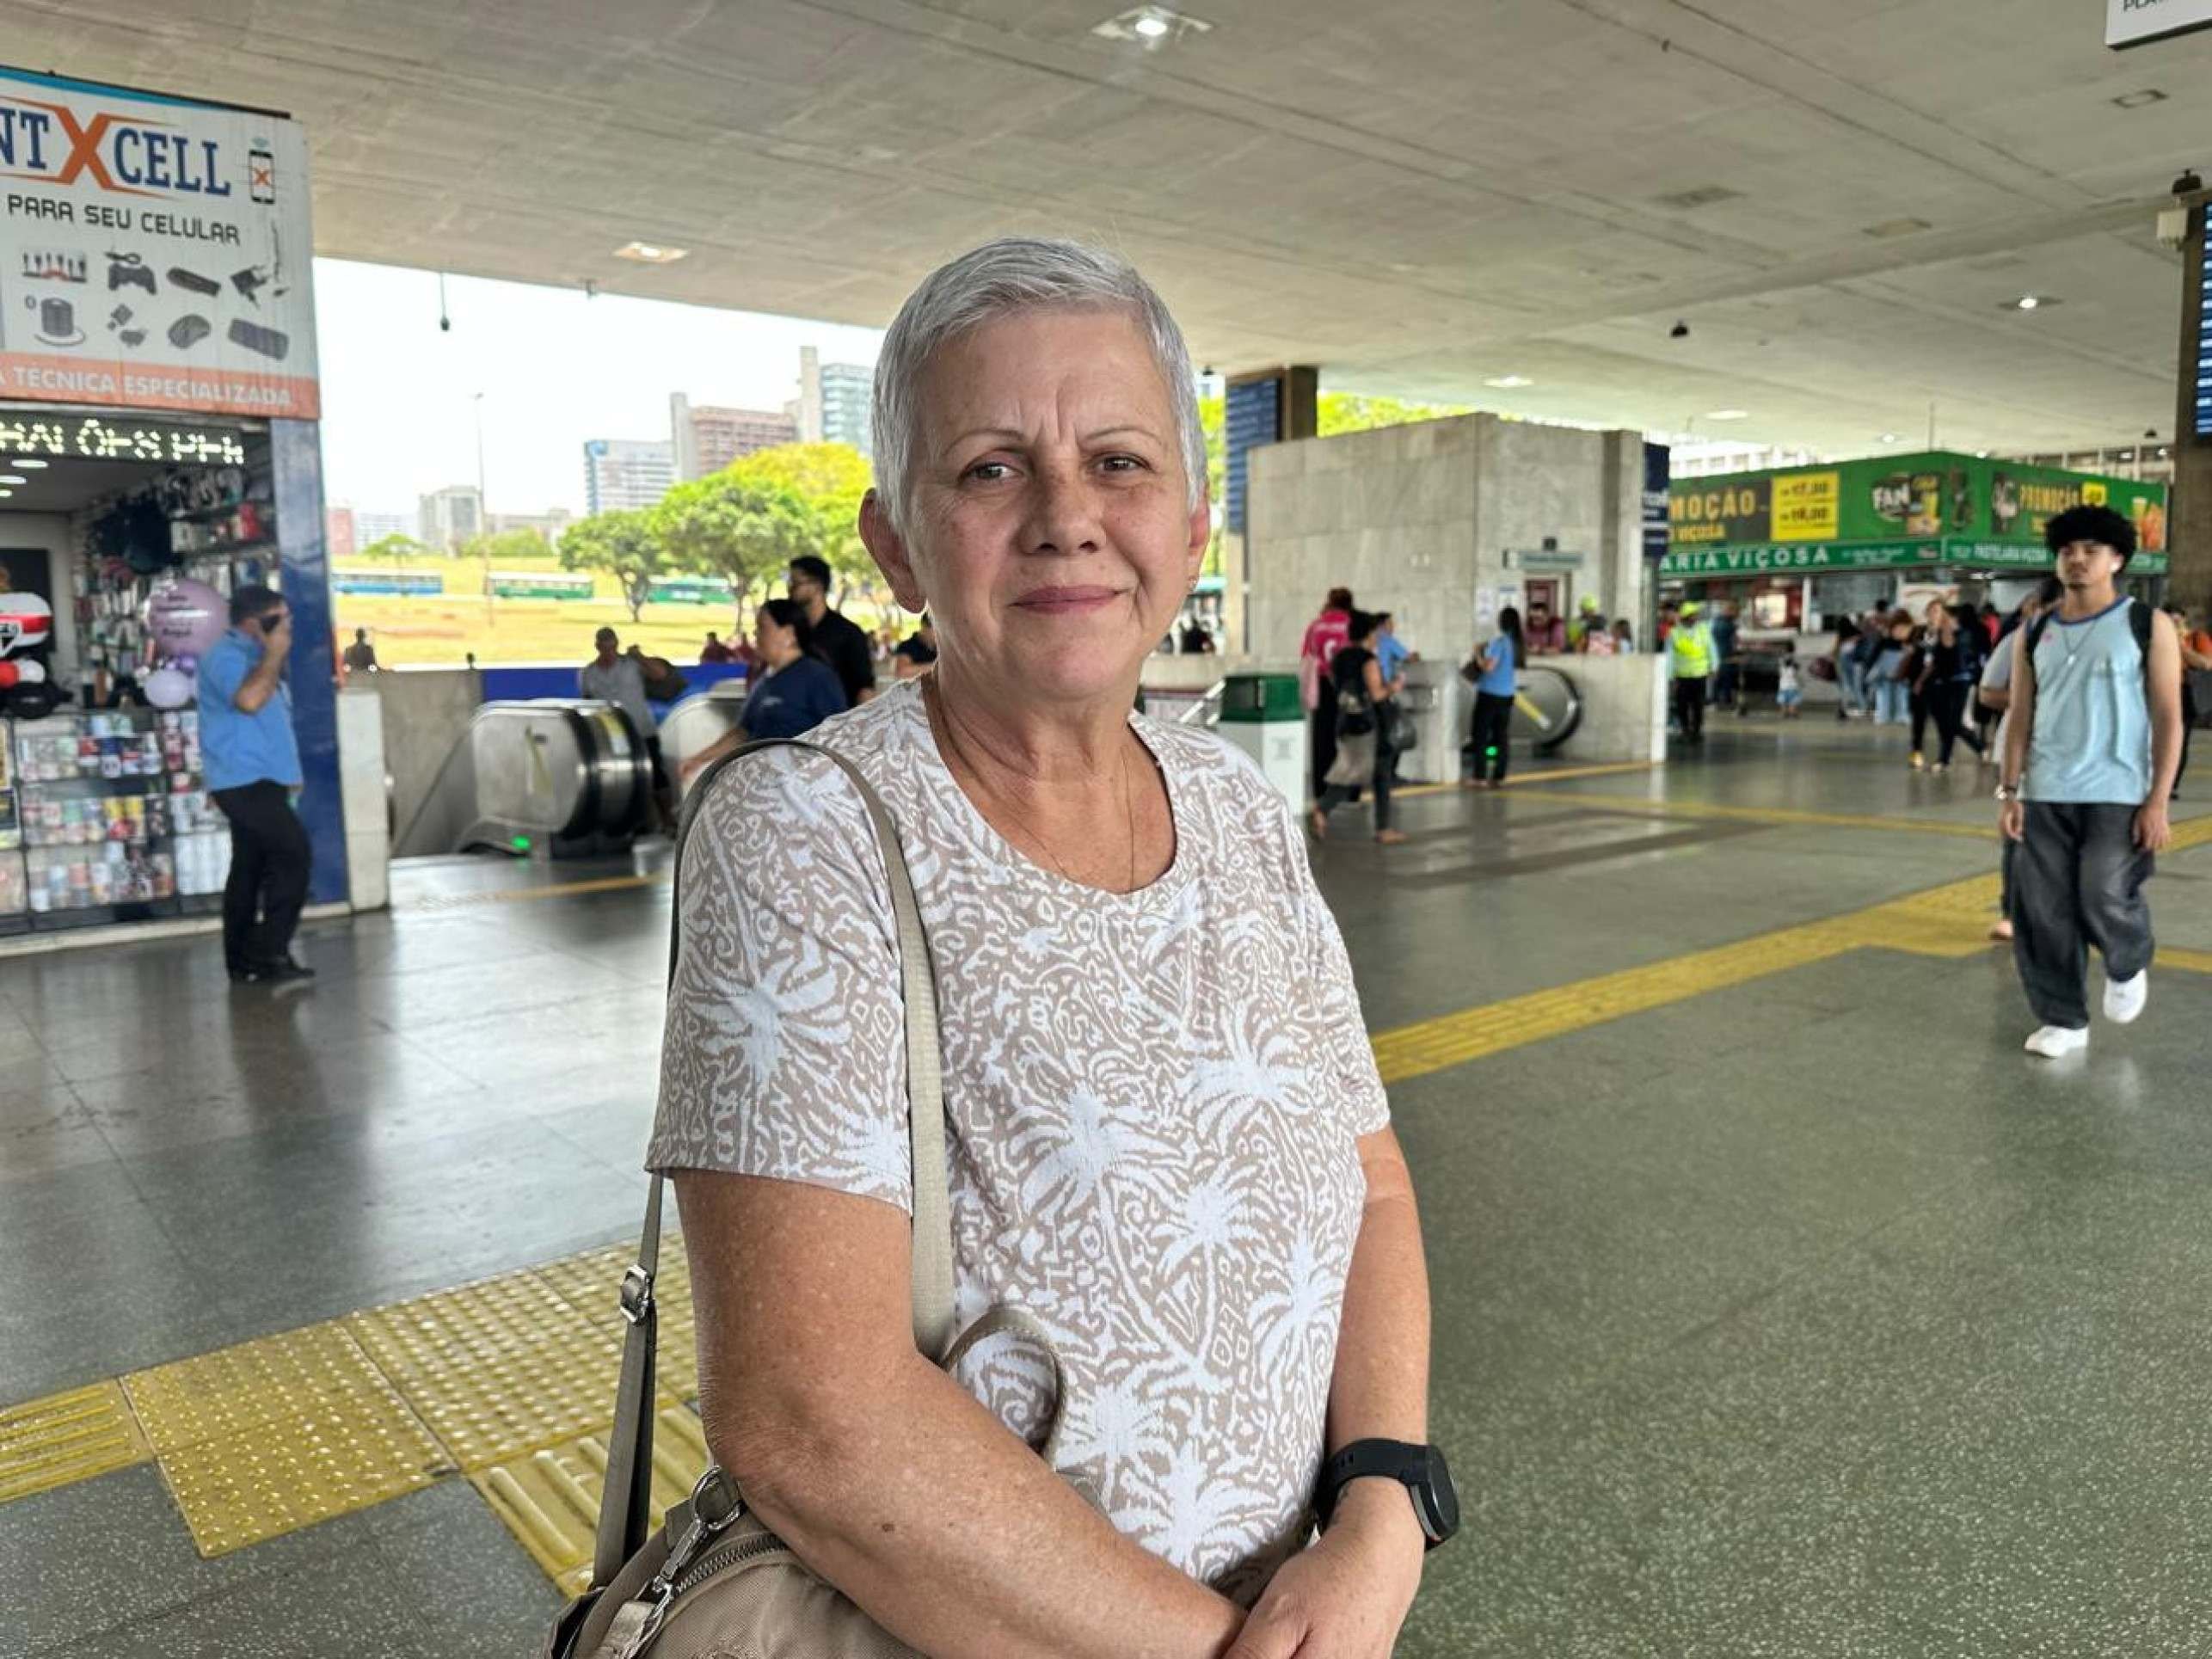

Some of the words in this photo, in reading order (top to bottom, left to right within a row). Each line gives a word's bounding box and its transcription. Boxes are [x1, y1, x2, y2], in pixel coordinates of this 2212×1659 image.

[7, 193, 73, 223] PARA
[84, 205, 131, 230] SEU
[141, 212, 240, 246] CELULAR
[124, 375, 292, 406] ESPECIALIZADA
[1726, 544, 1829, 570] VIÇOSA
